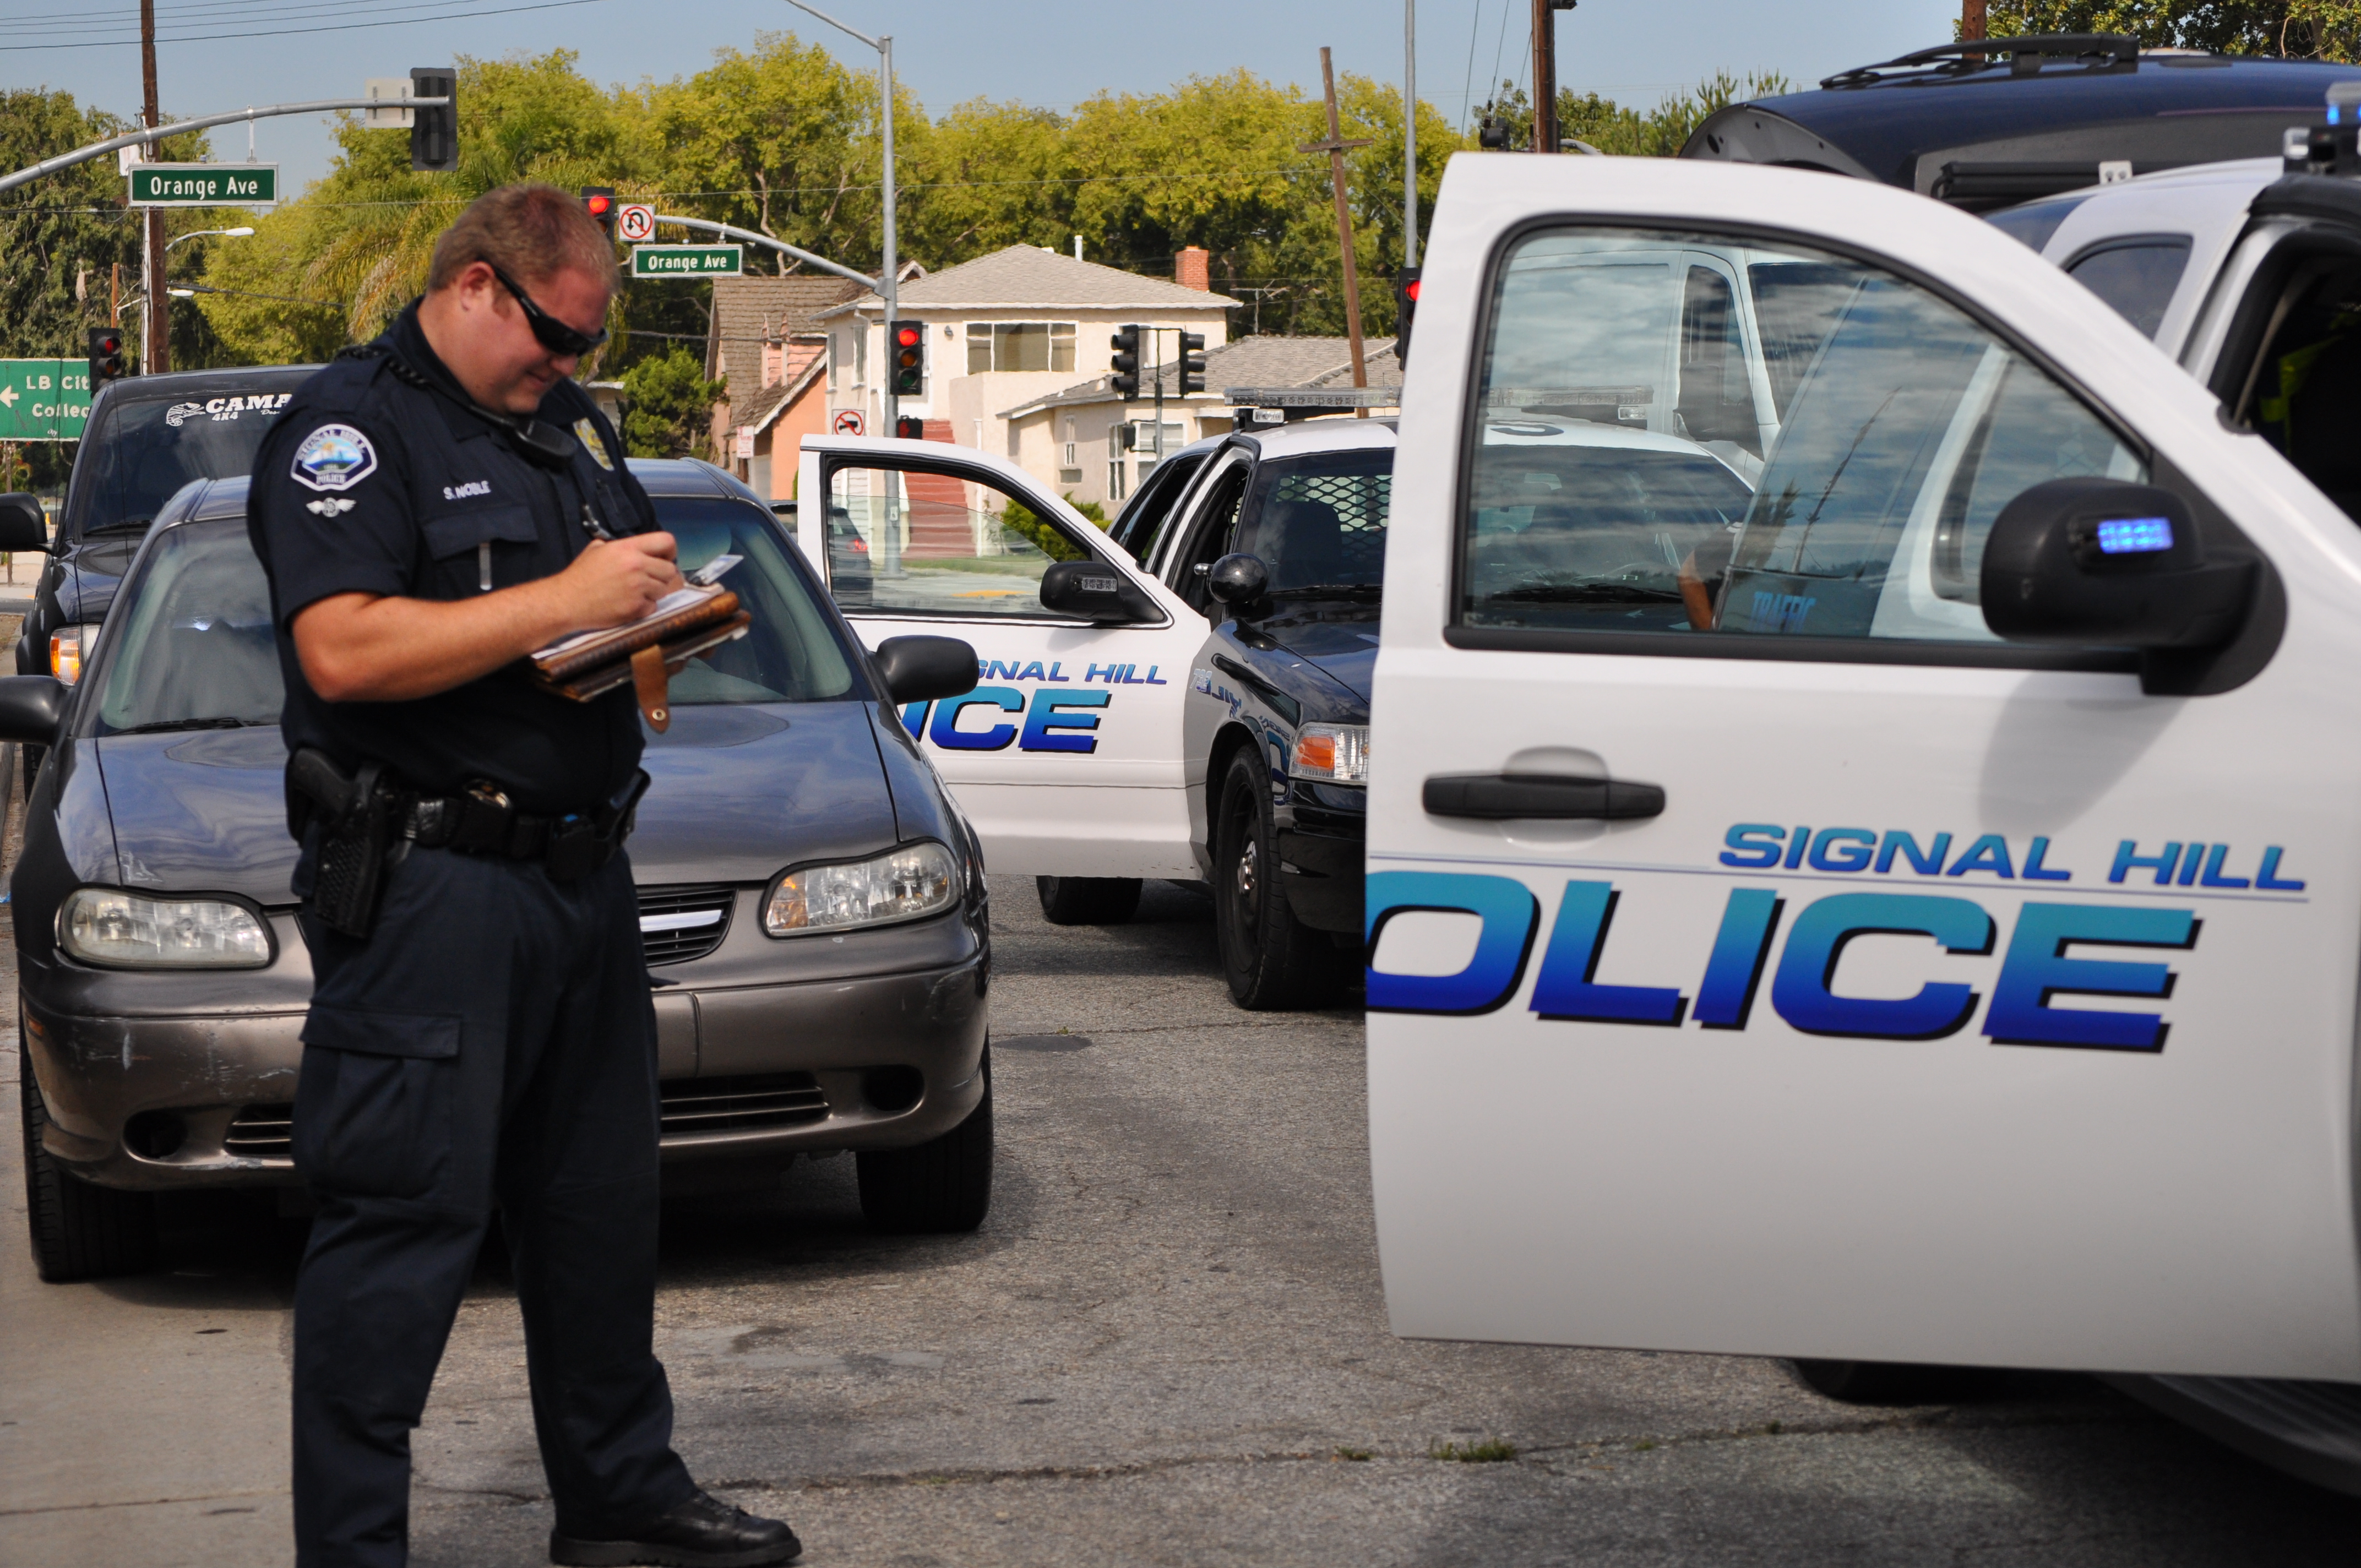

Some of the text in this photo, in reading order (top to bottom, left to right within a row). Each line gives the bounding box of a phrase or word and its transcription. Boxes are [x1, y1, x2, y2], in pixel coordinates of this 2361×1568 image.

[150, 176, 258, 200] Orange Ave
[648, 254, 727, 273] Orange Ave
[26, 375, 90, 390] LB Cit
[32, 402, 90, 418] Colle
[205, 393, 292, 413] CAMA
[316, 473, 347, 486] POLICE
[1084, 663, 1167, 685] HILL
[1718, 823, 2306, 891] SIGNAL HILL
[1366, 870, 2204, 1054] OLICE
